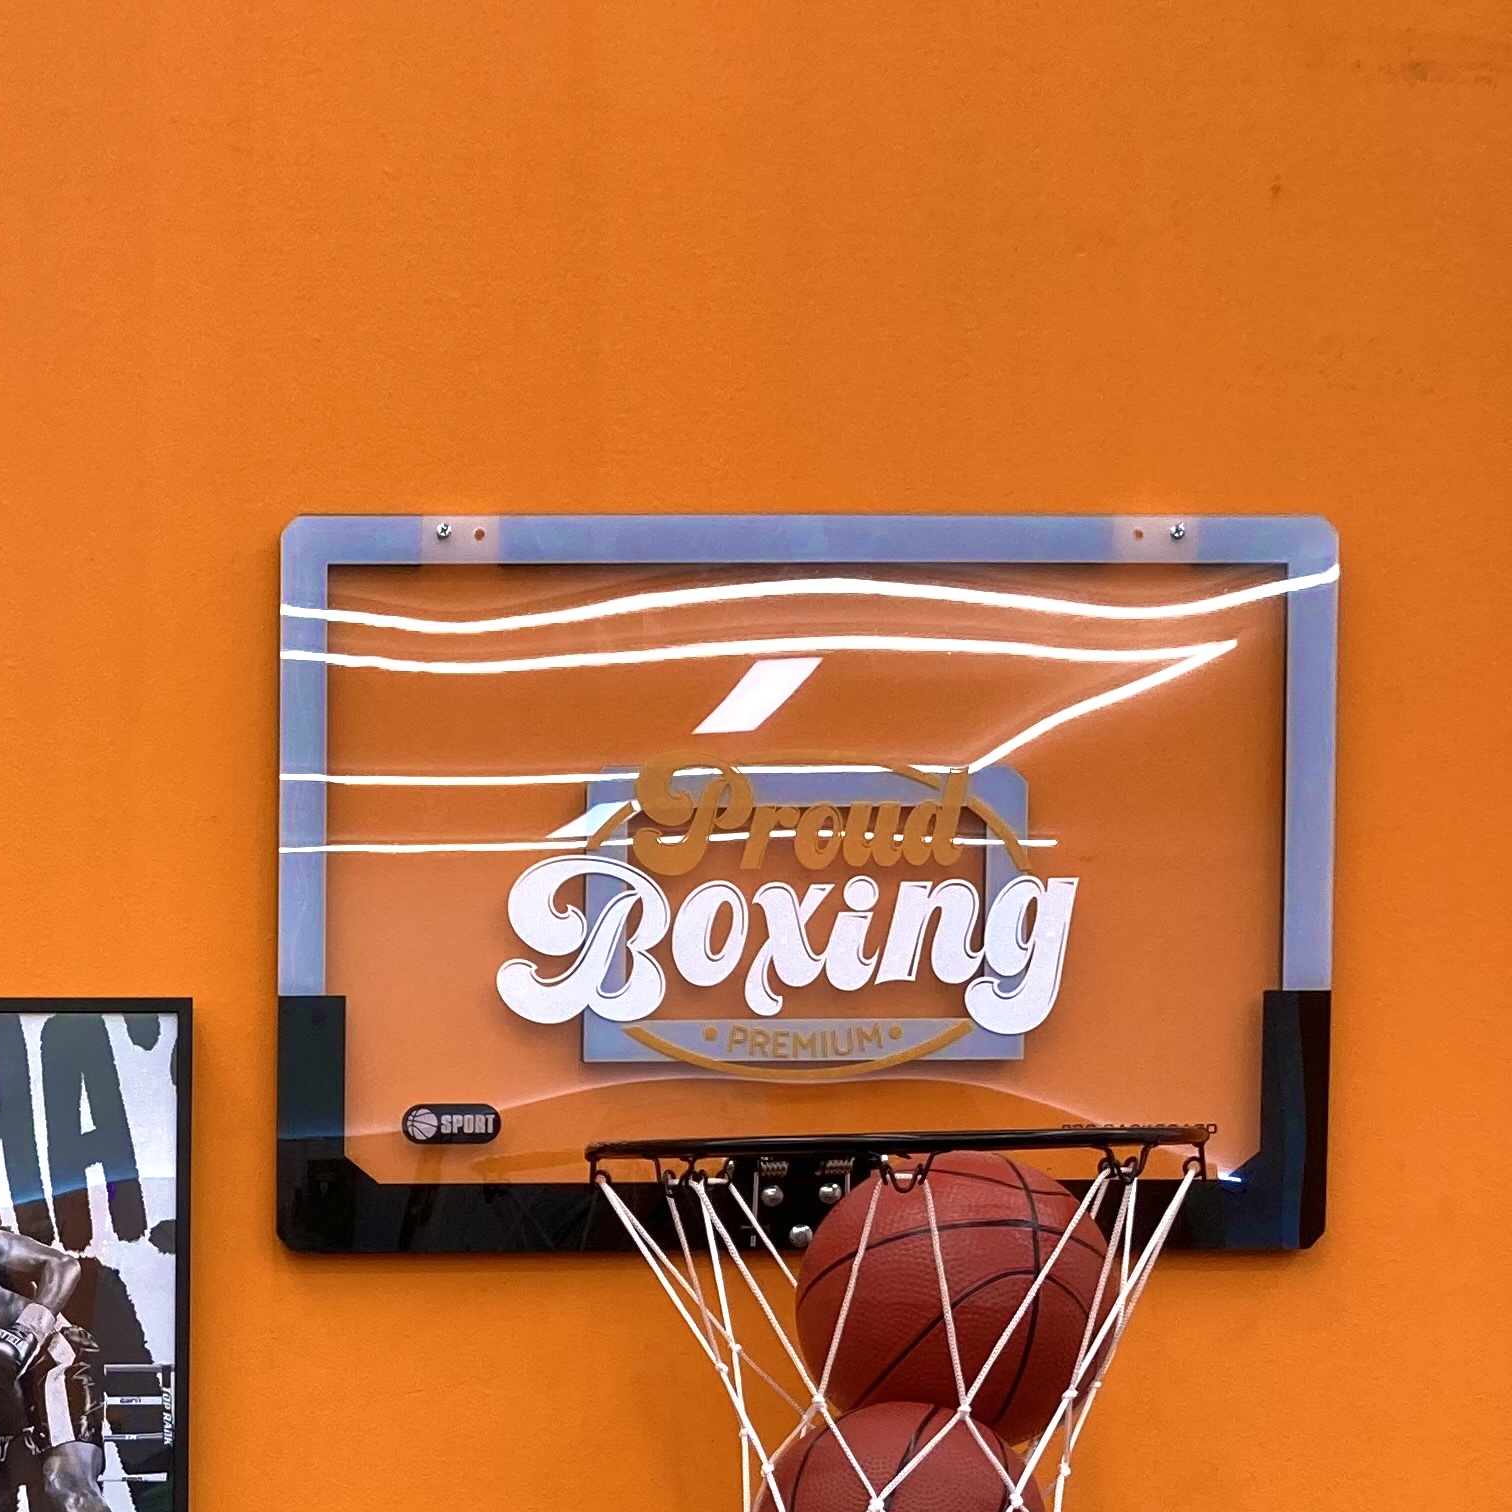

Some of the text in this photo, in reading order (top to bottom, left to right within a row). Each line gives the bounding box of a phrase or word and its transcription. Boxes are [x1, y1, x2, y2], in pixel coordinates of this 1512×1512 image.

[631, 750, 970, 876] Proud
[496, 854, 1080, 1035] Boxing
[726, 1021, 884, 1059] PREMIUM
[440, 1114, 495, 1134] SPORT
